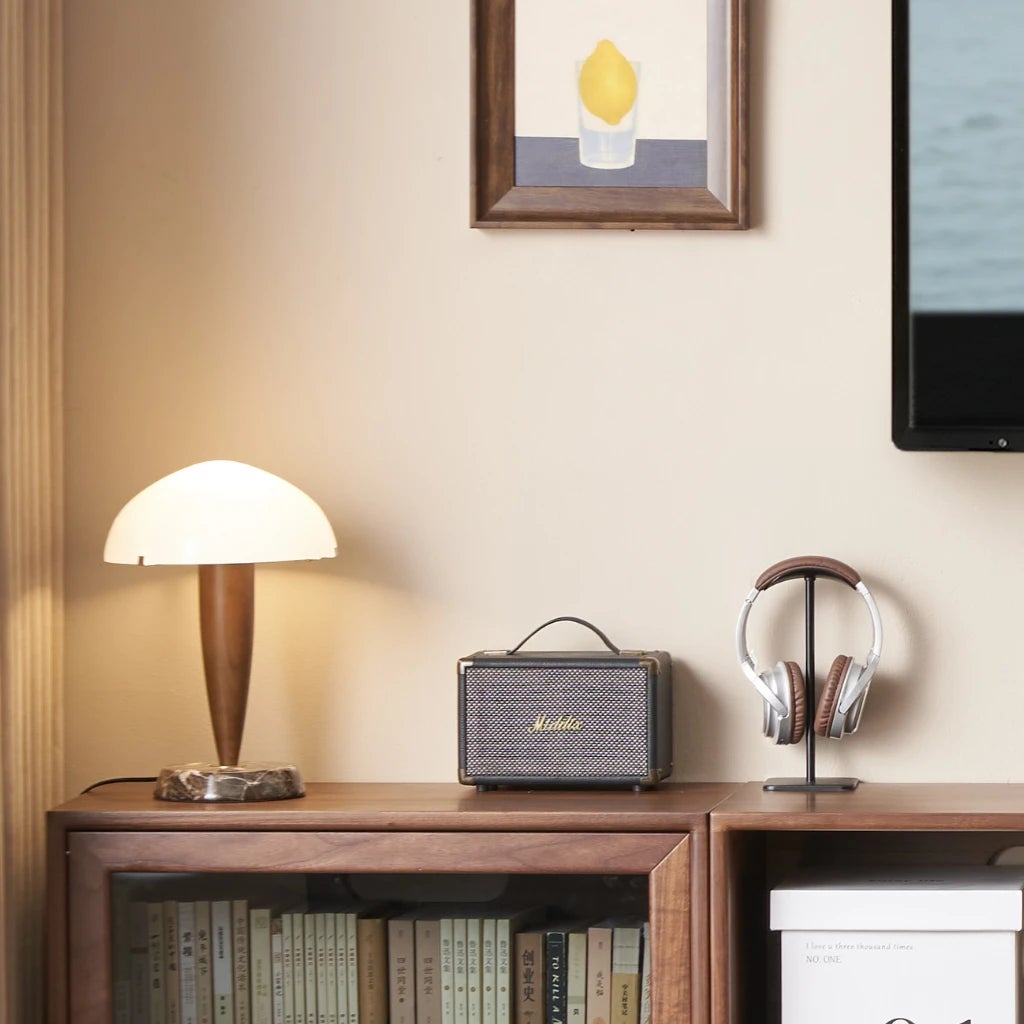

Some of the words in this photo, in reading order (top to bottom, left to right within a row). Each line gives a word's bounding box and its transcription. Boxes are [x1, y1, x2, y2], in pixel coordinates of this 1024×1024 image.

[834, 942, 855, 950] three
[856, 942, 891, 950] thousand
[552, 956, 559, 969] TO
[522, 950, 536, 1002] 创业史
[552, 974, 560, 1001] KILL
